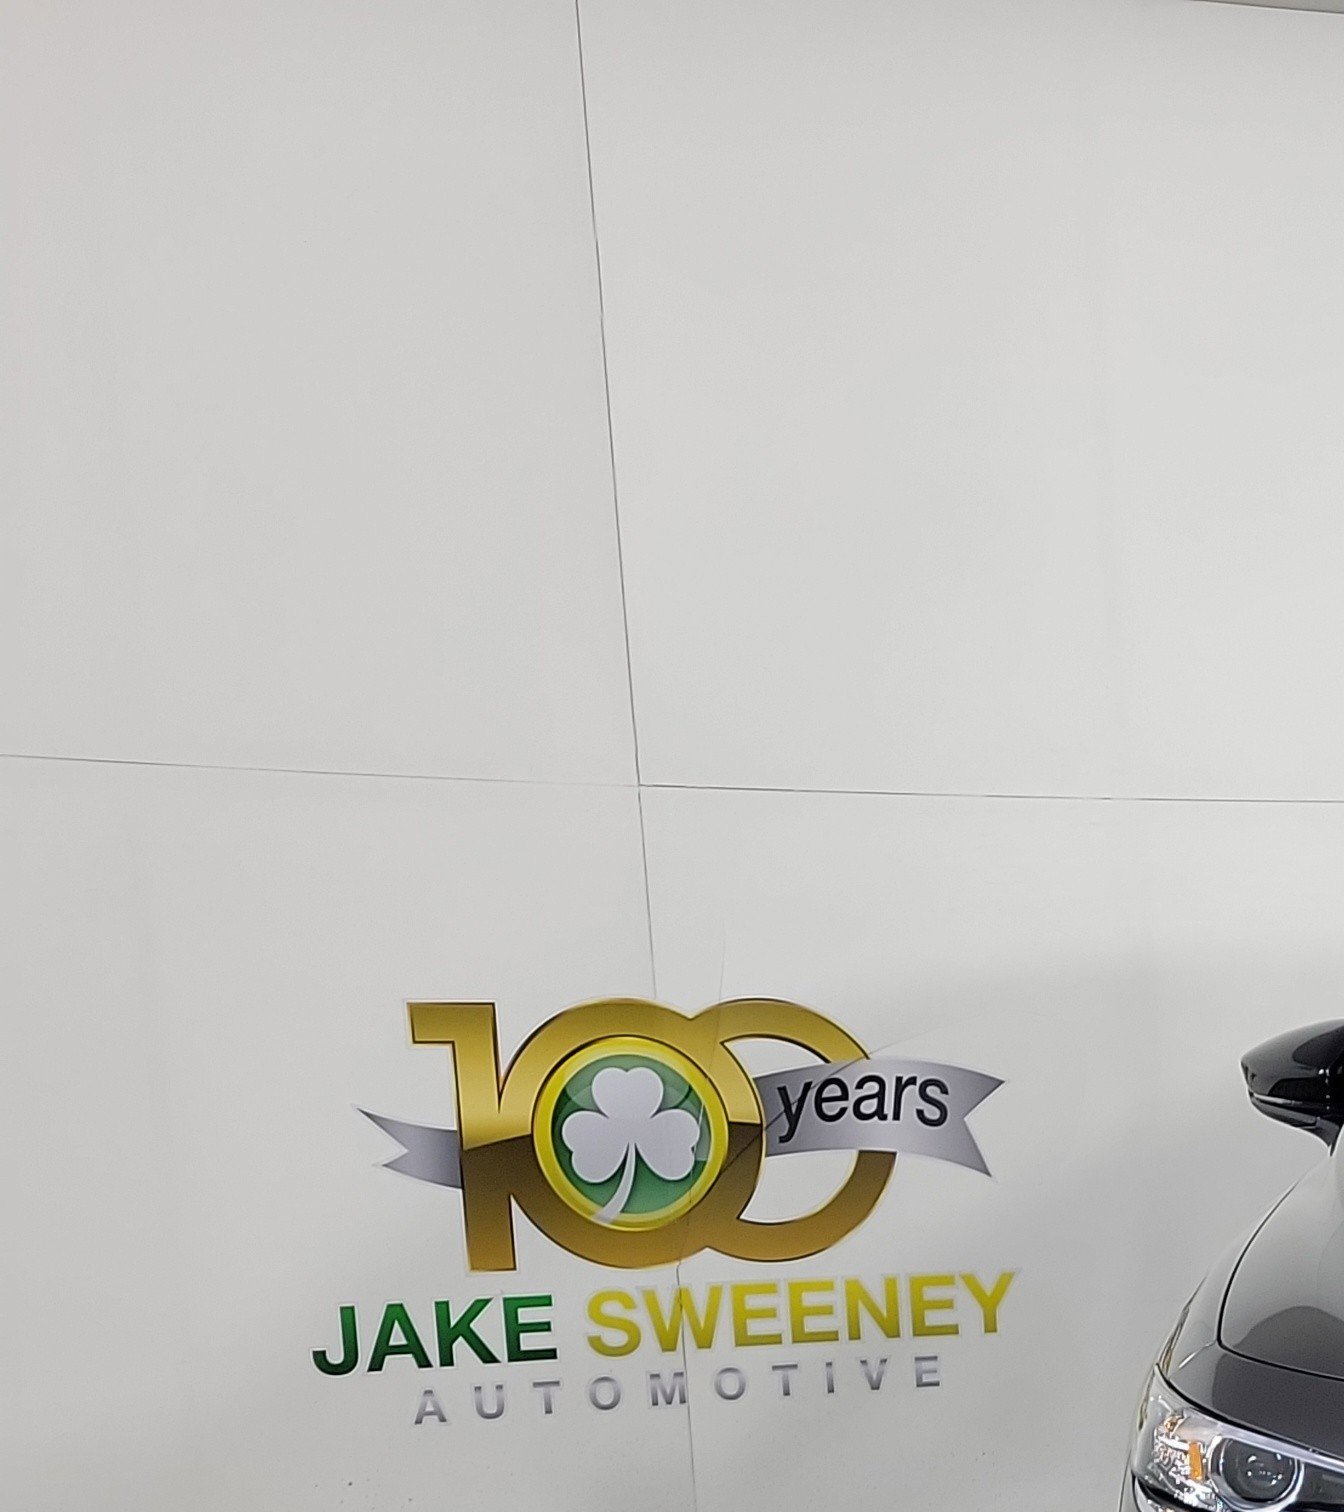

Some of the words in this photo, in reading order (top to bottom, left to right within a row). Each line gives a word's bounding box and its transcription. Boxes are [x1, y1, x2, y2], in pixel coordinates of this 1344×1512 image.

[406, 997, 898, 1271] 100
[777, 1074, 950, 1144] years
[311, 1294, 558, 1376] JAKE
[585, 1270, 1015, 1358] SWEENEY
[413, 1356, 941, 1426] AUTOMOTIVE
